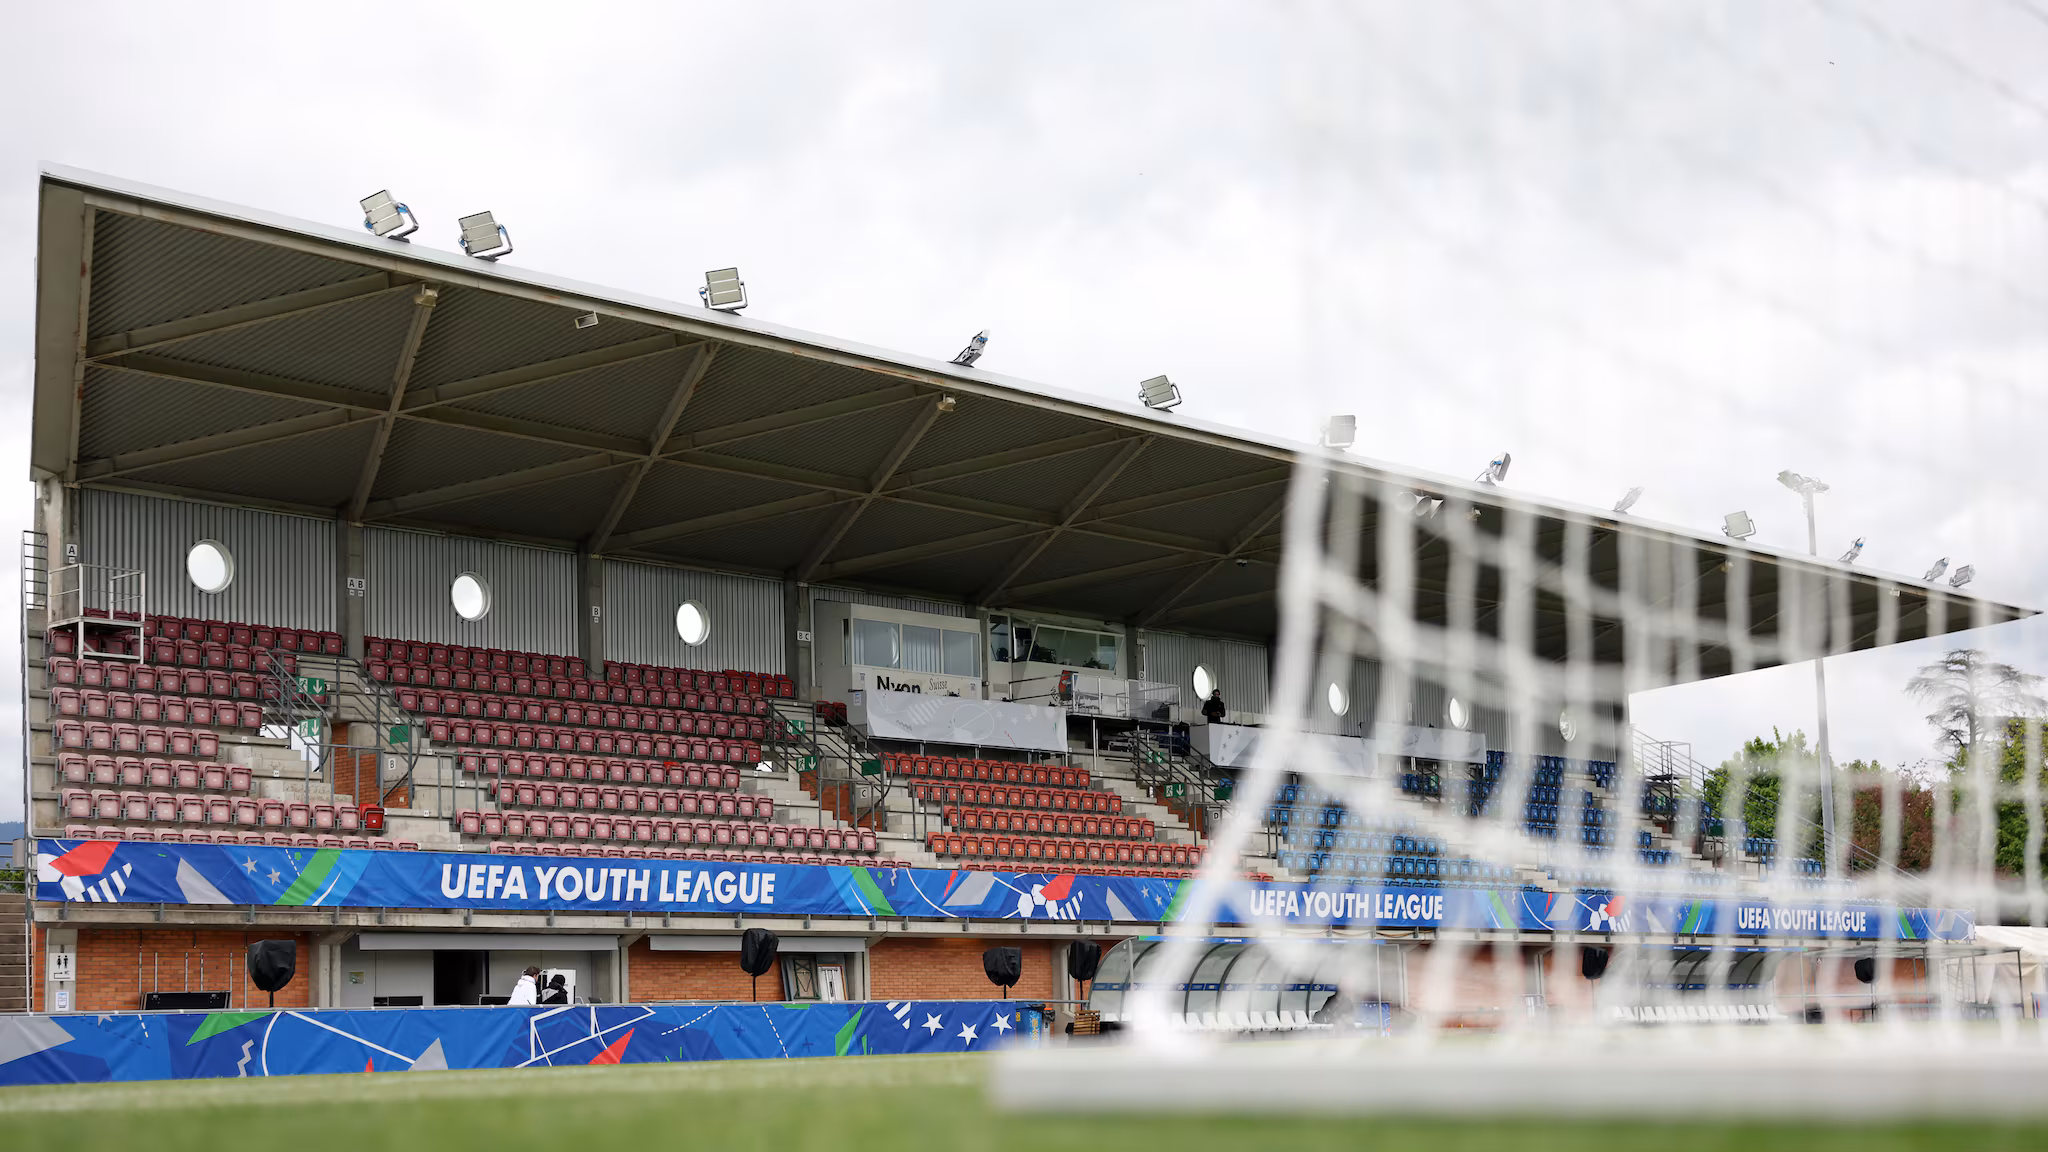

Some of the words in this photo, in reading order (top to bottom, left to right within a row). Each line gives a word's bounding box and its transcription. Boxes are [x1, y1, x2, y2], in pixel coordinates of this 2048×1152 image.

[68, 545, 76, 555] A
[929, 677, 948, 691] Suisse
[390, 759, 395, 769] B
[441, 863, 528, 899] UEFA
[533, 866, 651, 901] YOUTH
[658, 869, 776, 904] LEAGUE
[1251, 889, 1300, 917] UEFA
[1302, 891, 1369, 918] YOUTH
[1375, 893, 1443, 920] LEAGUE
[1738, 907, 1771, 929] UEFA
[1772, 908, 1817, 930] YOUTH
[1820, 910, 1867, 932] LEAGUE
